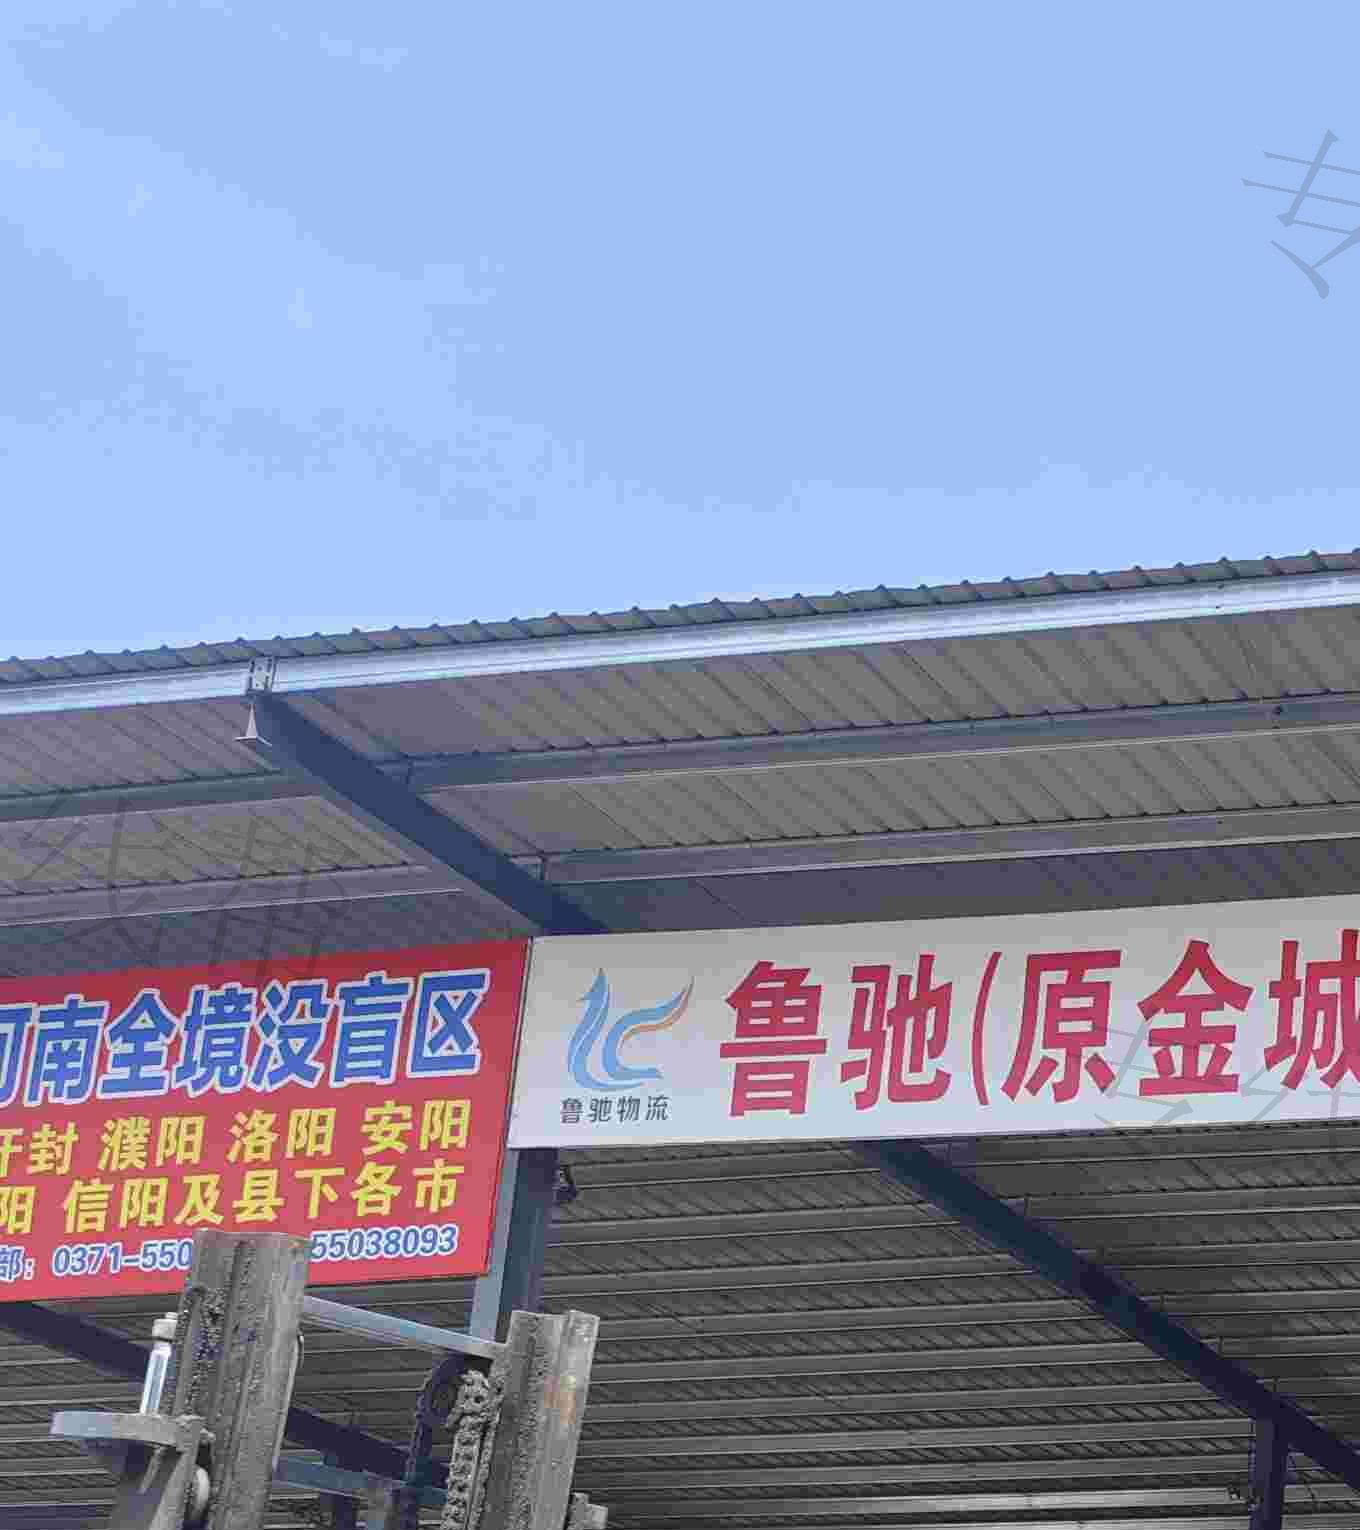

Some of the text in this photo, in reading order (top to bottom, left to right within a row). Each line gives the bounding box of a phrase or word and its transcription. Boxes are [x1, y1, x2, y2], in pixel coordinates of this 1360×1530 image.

[98, 1115, 207, 1172] 濮阳
[226, 1107, 336, 1164] 洛阳
[361, 1099, 470, 1157] 安阳
[560, 1095, 671, 1124] 鲁驰物流
[63, 1158, 465, 1234] 信阳及县下各市
[53, 1238, 193, 1276] 0371-550
[311, 1224, 458, 1263] 55038093
